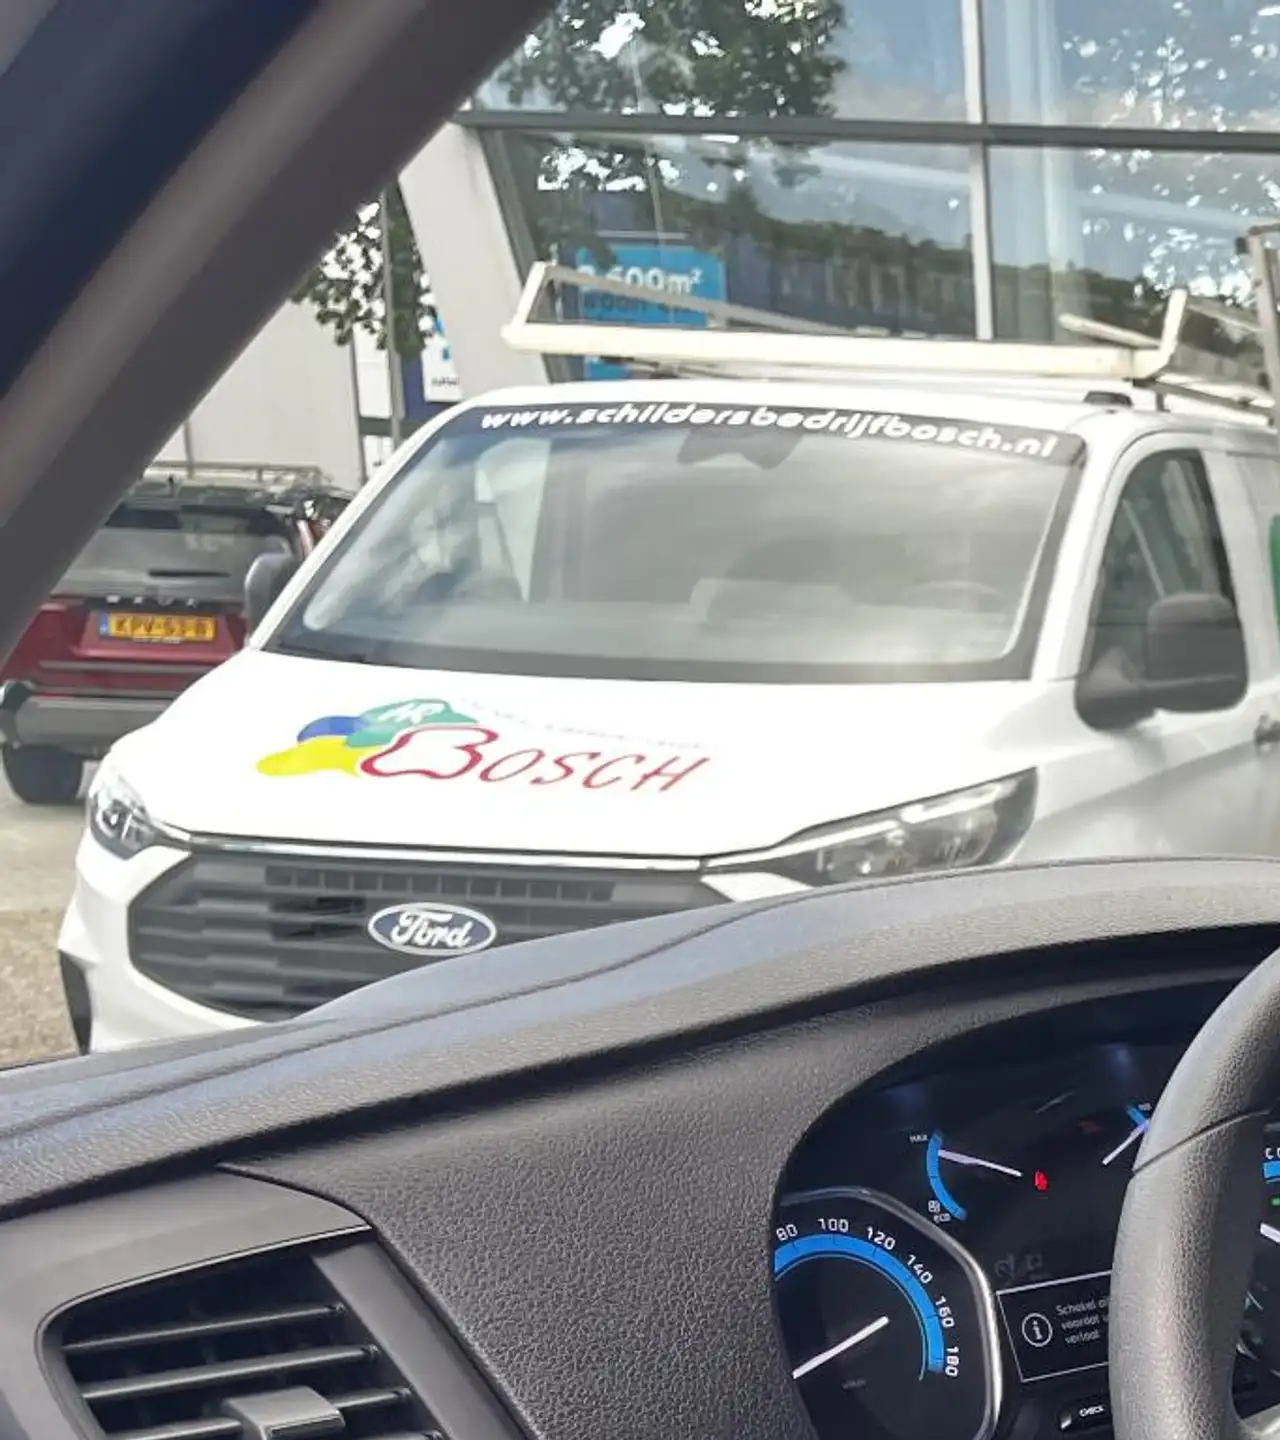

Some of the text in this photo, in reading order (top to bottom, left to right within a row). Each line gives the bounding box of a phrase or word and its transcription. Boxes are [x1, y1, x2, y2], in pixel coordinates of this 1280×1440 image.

[480, 402, 1058, 459] www.schildersbedrijfbosch.nl
[360, 725, 710, 792] BOSCH
[389, 909, 472, 951] Ford
[775, 1223, 799, 1242] 80
[817, 1217, 850, 1233] 100
[865, 1226, 897, 1251] 120
[907, 1254, 934, 1285] 140
[935, 1295, 956, 1329] 160
[944, 1345, 960, 1378] 180
